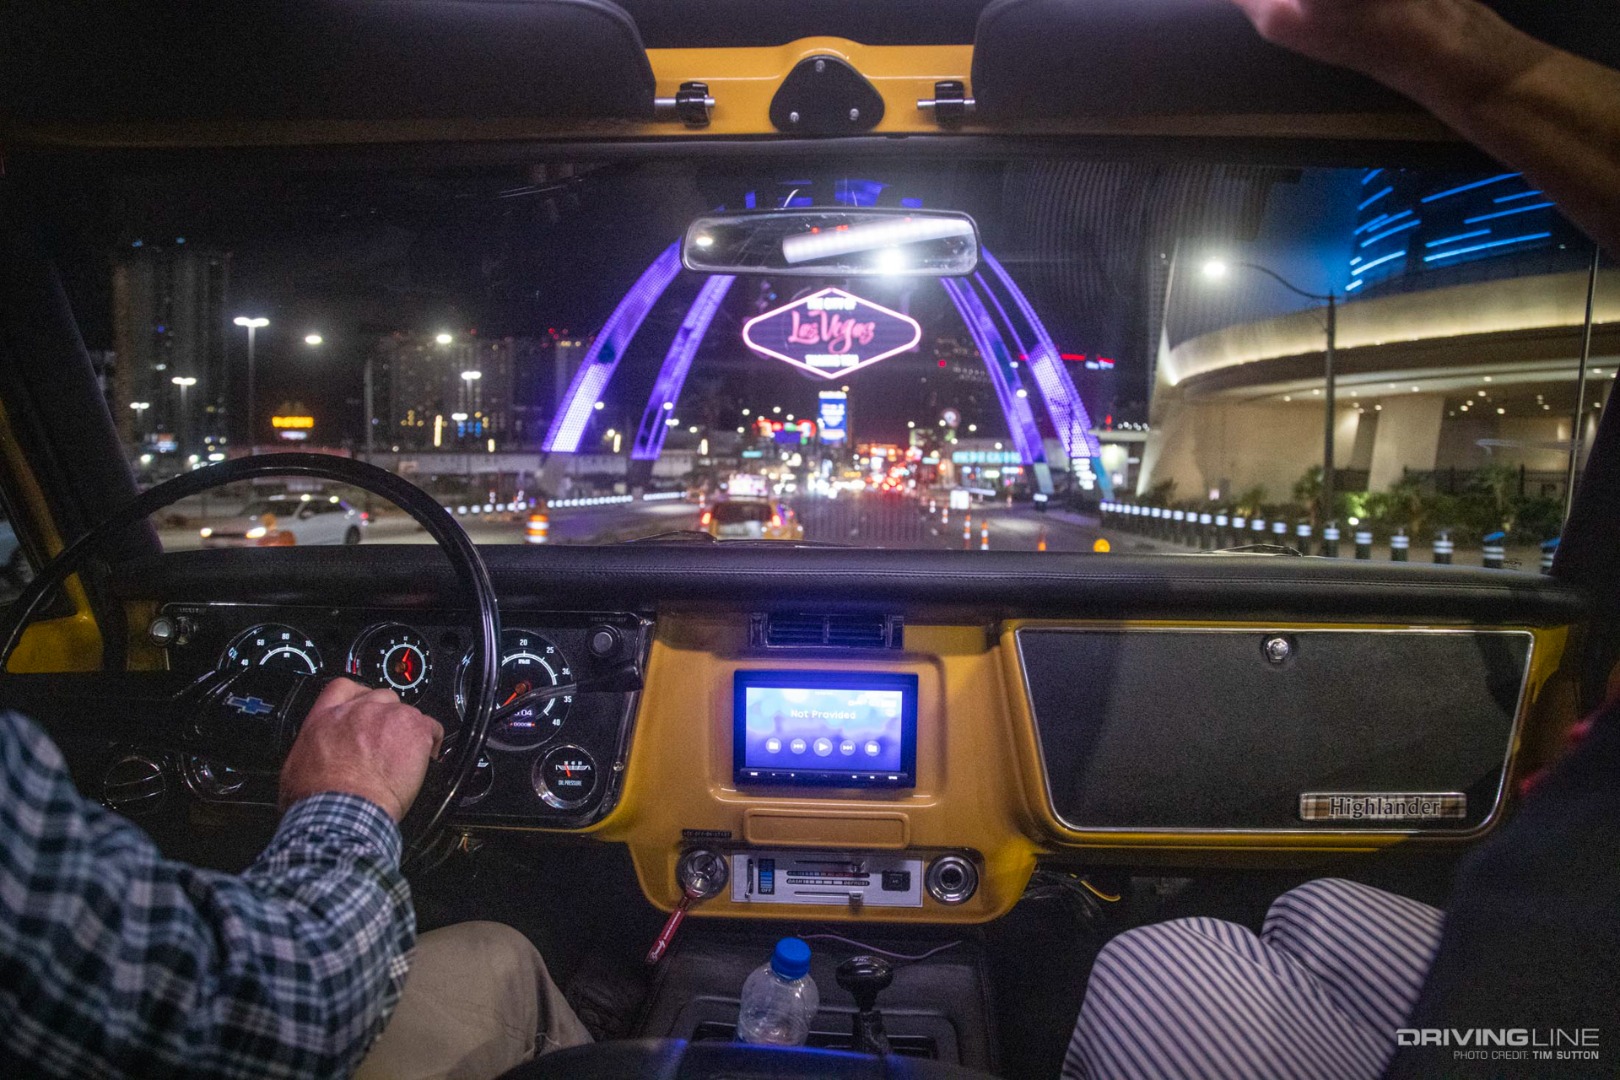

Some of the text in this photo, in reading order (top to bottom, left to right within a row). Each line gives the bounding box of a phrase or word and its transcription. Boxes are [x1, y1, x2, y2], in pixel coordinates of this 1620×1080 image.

[807, 309, 876, 355] Vegas
[281, 632, 290, 640] 80
[519, 638, 528, 646] 20
[546, 646, 554, 654] 25
[791, 710, 808, 718] Not
[1329, 797, 1440, 819] Highlander
